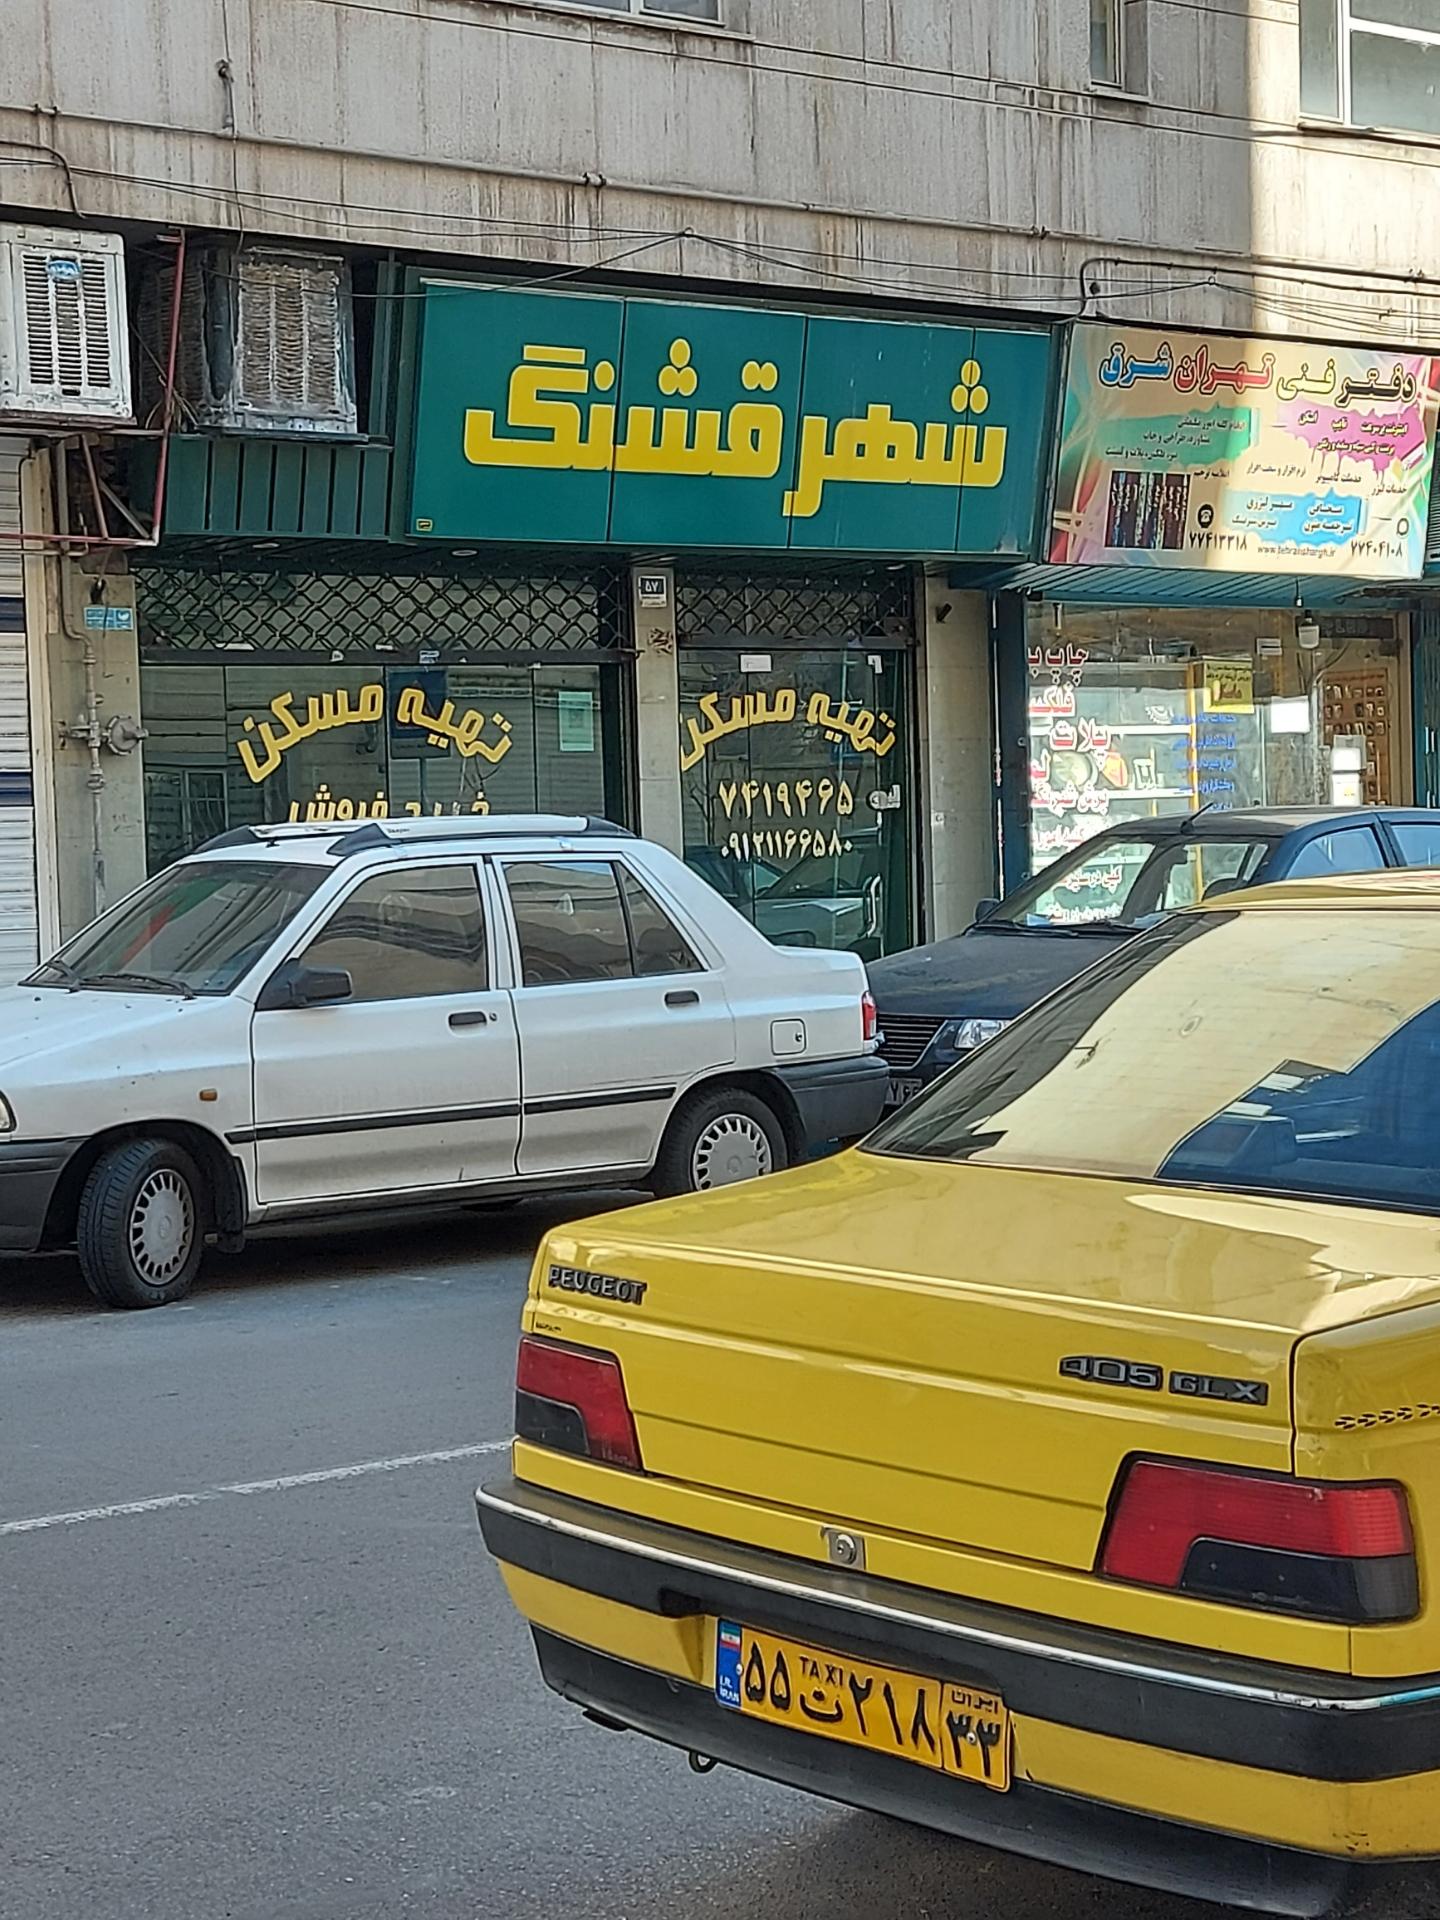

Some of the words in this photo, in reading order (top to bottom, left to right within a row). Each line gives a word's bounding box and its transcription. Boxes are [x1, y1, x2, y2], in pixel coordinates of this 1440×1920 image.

[1099, 341, 1173, 387] شرق
[1173, 345, 1276, 394] تهران
[1276, 359, 1336, 400] فنی
[1335, 363, 1416, 405] دفتر
[464, 338, 785, 478] قشنگ
[783, 359, 1008, 517] شهر
[236, 684, 384, 784] مسکن
[397, 687, 513, 763] تهیه
[680, 688, 796, 772] مسکن
[806, 692, 896, 757] تهیه
[718, 777, 854, 819] ۷۴۱۹۴۶۵
[721, 828, 854, 862] ۰۹۱۲۱۱۶۶۵۸۰
[548, 1264, 648, 1306] PEUGEOT
[1059, 1355, 1164, 1391] 405
[1168, 1370, 1269, 1407] GLX
[719, 1686, 740, 1703] IRAN
[799, 1655, 844, 1687] TAXI
[951, 1689, 999, 1715] ایران
[946, 1709, 1001, 1777] ۳۳
